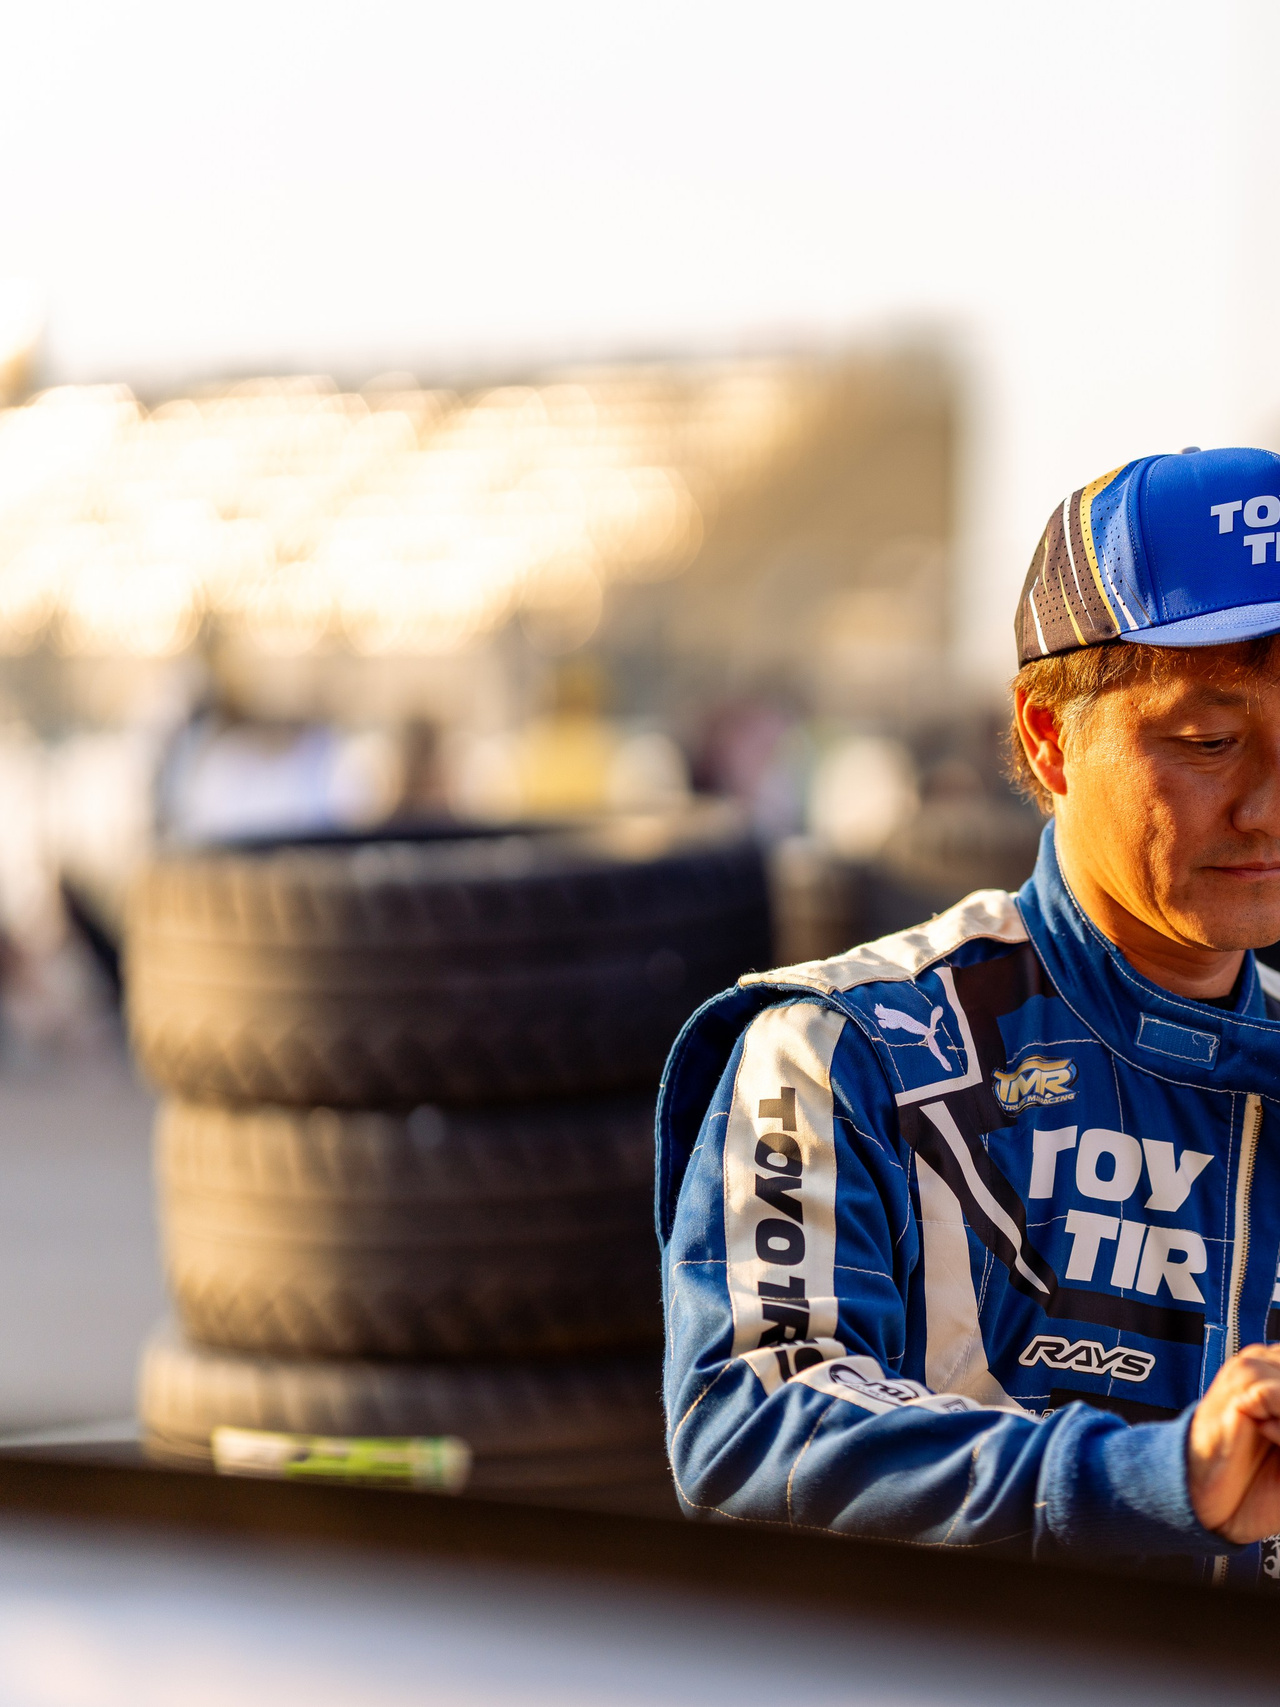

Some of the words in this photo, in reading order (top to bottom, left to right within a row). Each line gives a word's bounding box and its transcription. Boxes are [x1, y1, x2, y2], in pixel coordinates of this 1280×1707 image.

[993, 1058, 1072, 1103] TMR
[754, 1087, 806, 1266] TOYO
[1028, 1125, 1215, 1212] TOY
[1027, 1340, 1152, 1379] RAYS
